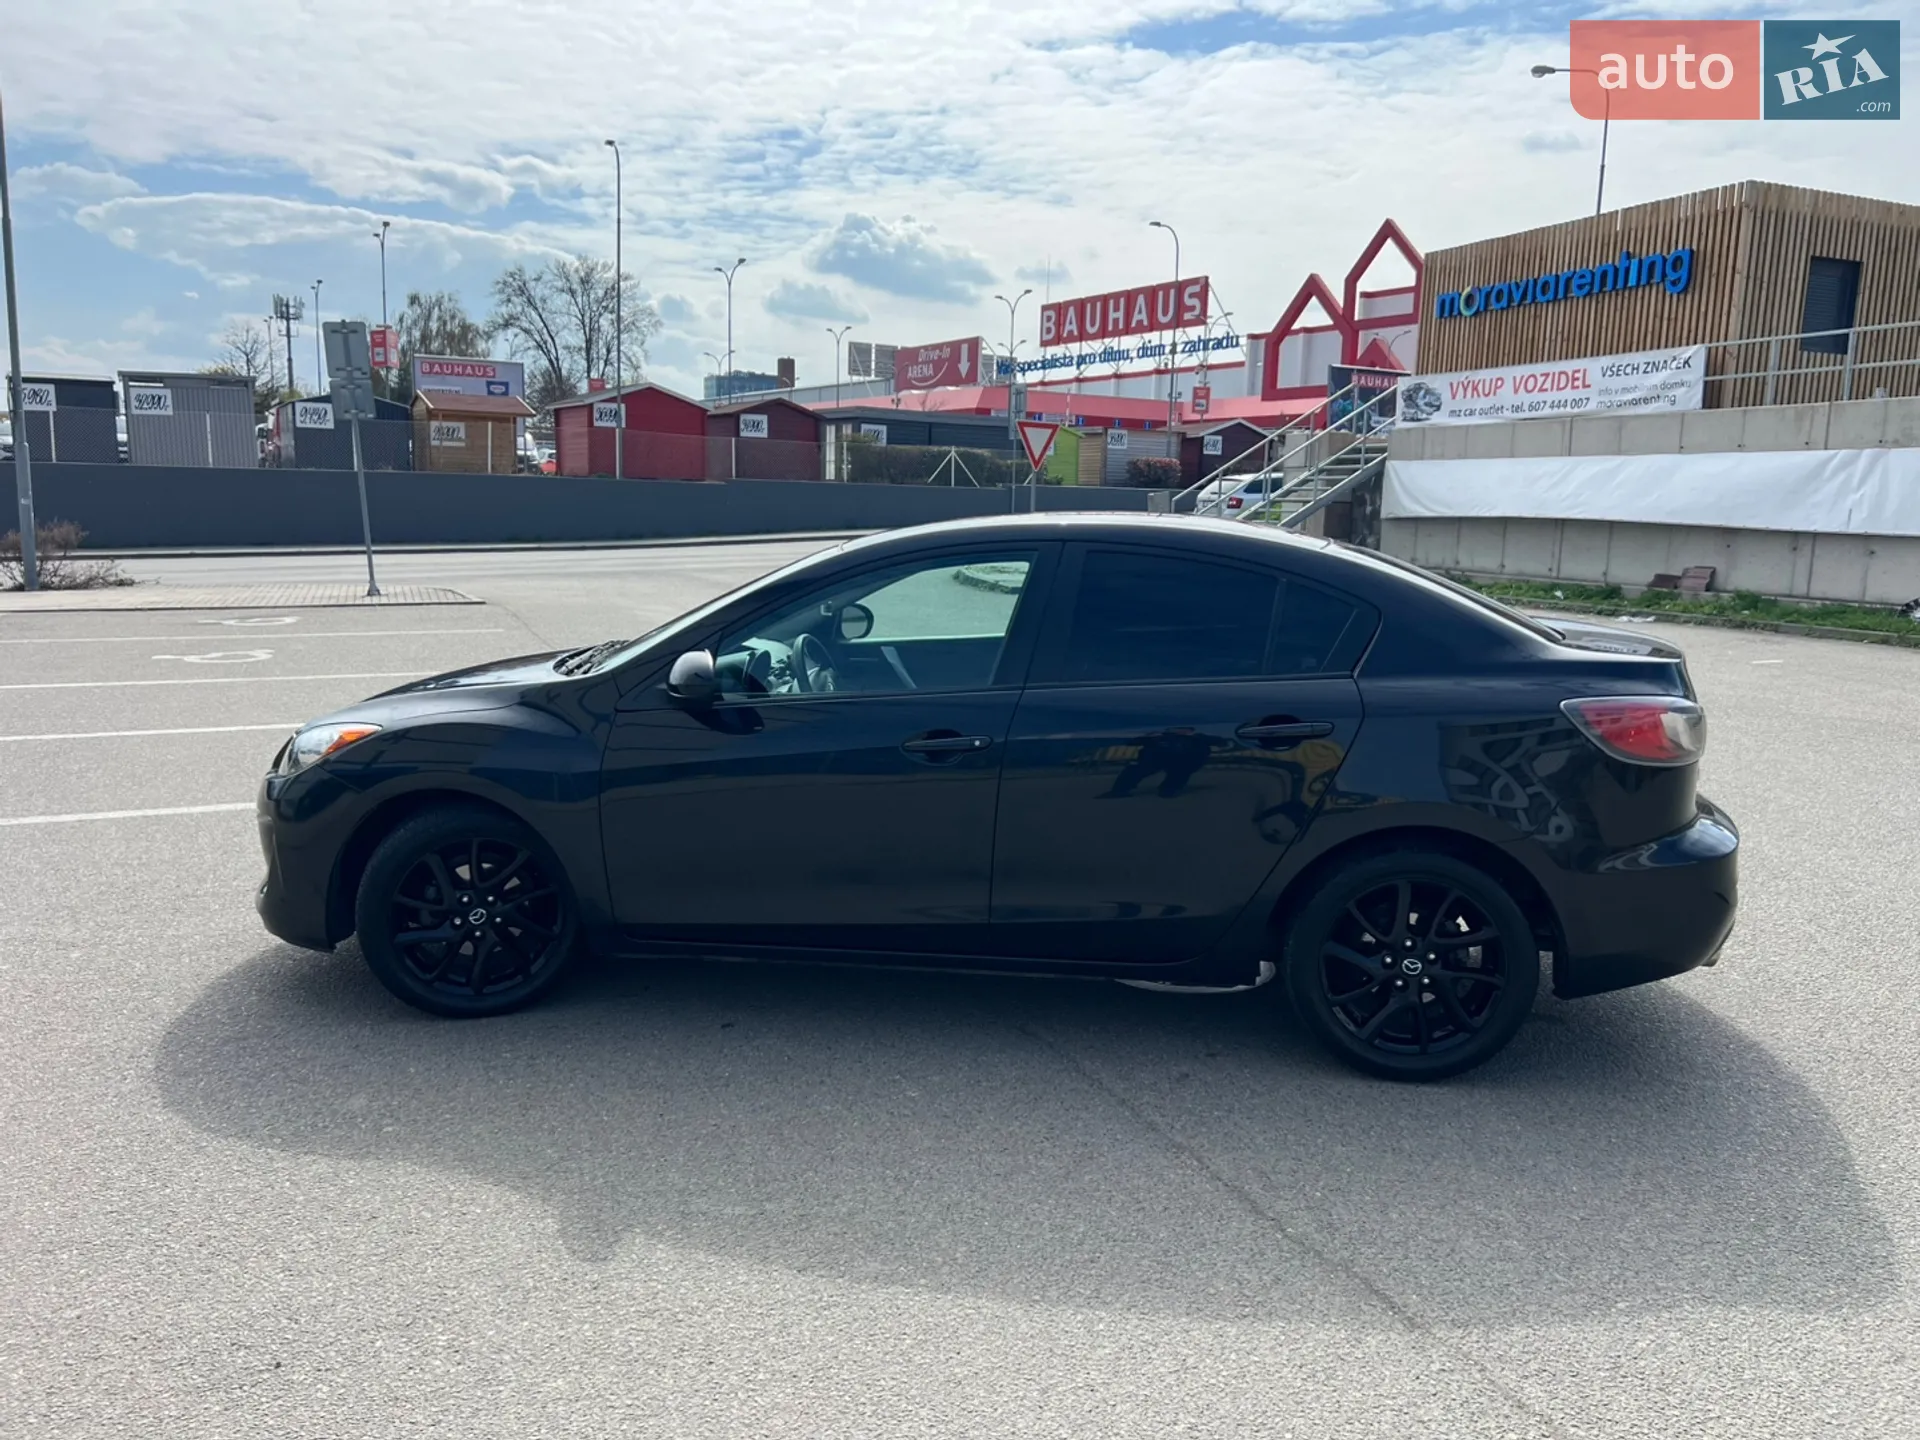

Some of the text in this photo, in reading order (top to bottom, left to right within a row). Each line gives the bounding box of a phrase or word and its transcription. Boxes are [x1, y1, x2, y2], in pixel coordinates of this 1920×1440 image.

[1435, 248, 1692, 318] moraviarenting
[1042, 284, 1201, 341] BAUHAUS
[918, 346, 951, 362] Drive-In
[1016, 354, 1074, 376] specialista
[1076, 352, 1096, 370] pro
[1181, 332, 1240, 353] zahradu
[422, 362, 494, 376] BAUHAUS
[907, 363, 934, 380] ARENA
[1601, 363, 1640, 378] VŠECH
[1449, 368, 1591, 400] VÝKUP VOZIDEL
[1448, 410, 1462, 418] mz
[1464, 407, 1477, 416] car
[1478, 404, 1504, 415] outlet
[1511, 402, 1526, 412] tel.
[1528, 400, 1545, 412] 607
[1548, 399, 1568, 410] 444
[1570, 397, 1590, 408] 007
[1597, 394, 1677, 408] moraviarentng
